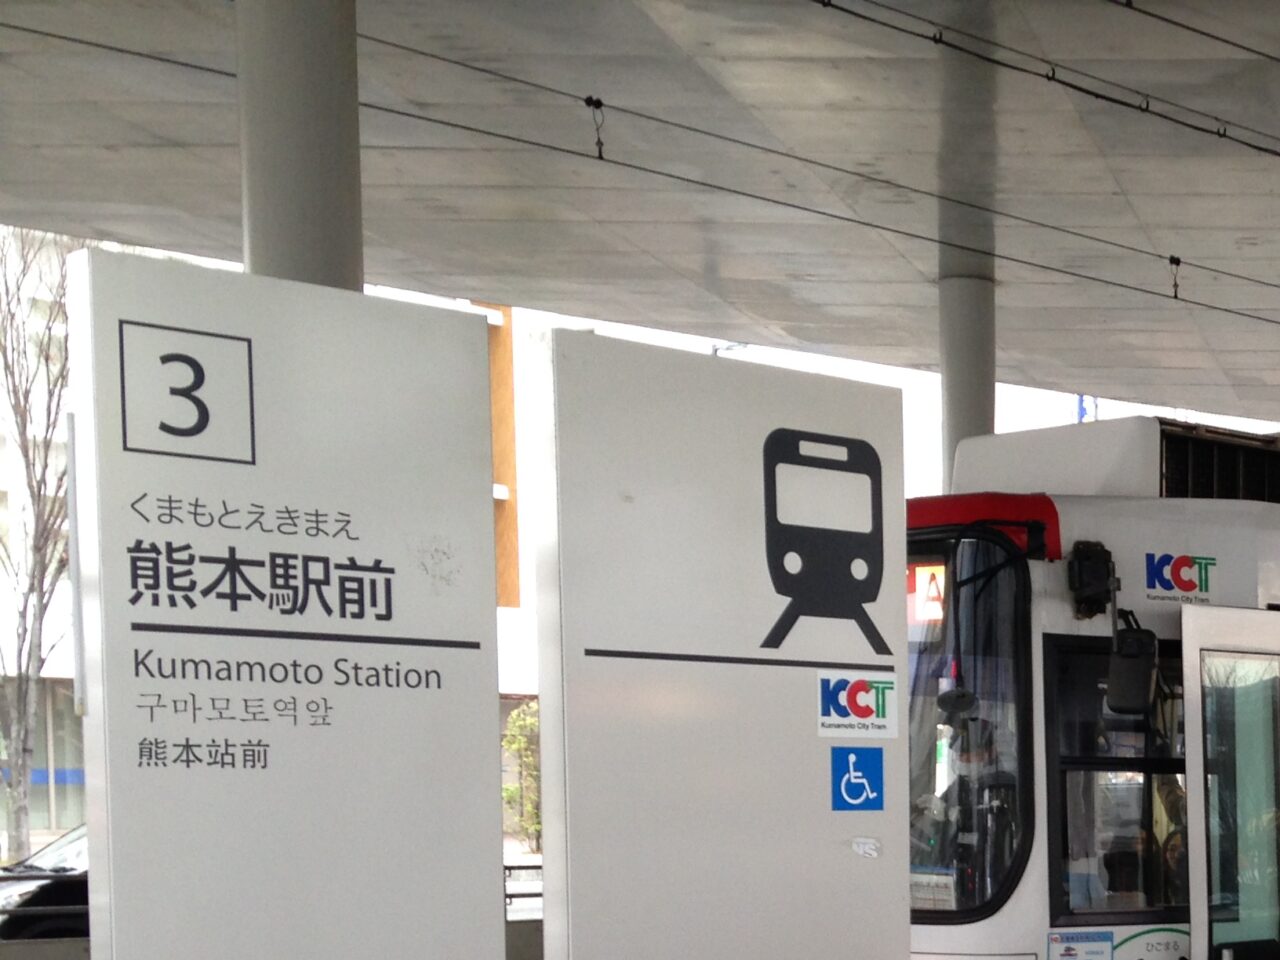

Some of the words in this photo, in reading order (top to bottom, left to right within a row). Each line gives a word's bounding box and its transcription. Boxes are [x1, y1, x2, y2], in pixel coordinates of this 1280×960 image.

[157, 352, 210, 437] 3
[130, 492, 360, 541] くまもとえきまえ
[126, 538, 396, 622] 熊本駅前
[1145, 552, 1217, 593] KCT
[133, 648, 324, 685] Kumamoto
[333, 657, 442, 690] Station
[136, 692, 334, 727] 구마모토역앞
[820, 678, 894, 719] KCT
[137, 737, 270, 770] 熊本站前
